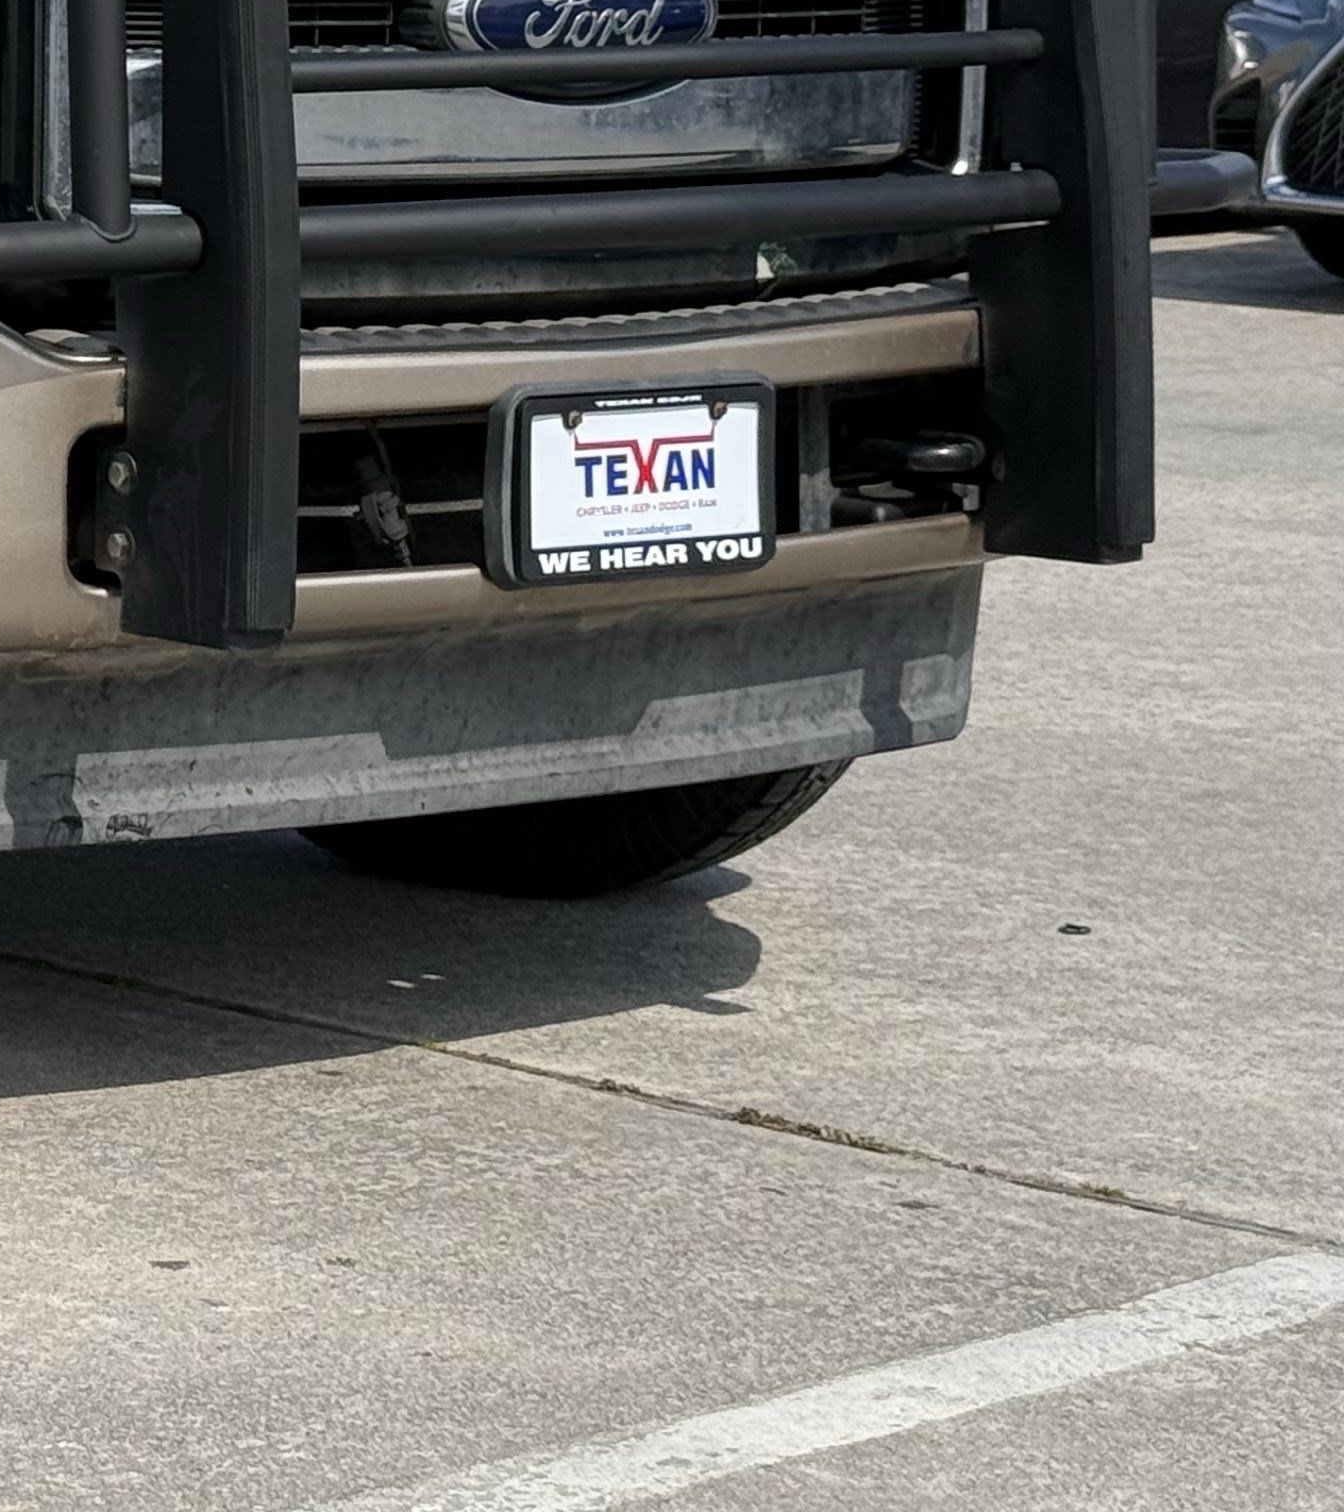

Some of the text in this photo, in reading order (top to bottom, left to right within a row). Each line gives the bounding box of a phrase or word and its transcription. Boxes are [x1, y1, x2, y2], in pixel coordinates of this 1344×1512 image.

[574, 440, 716, 499] TEXAN
[537, 537, 763, 576] WE HEAR YOU
